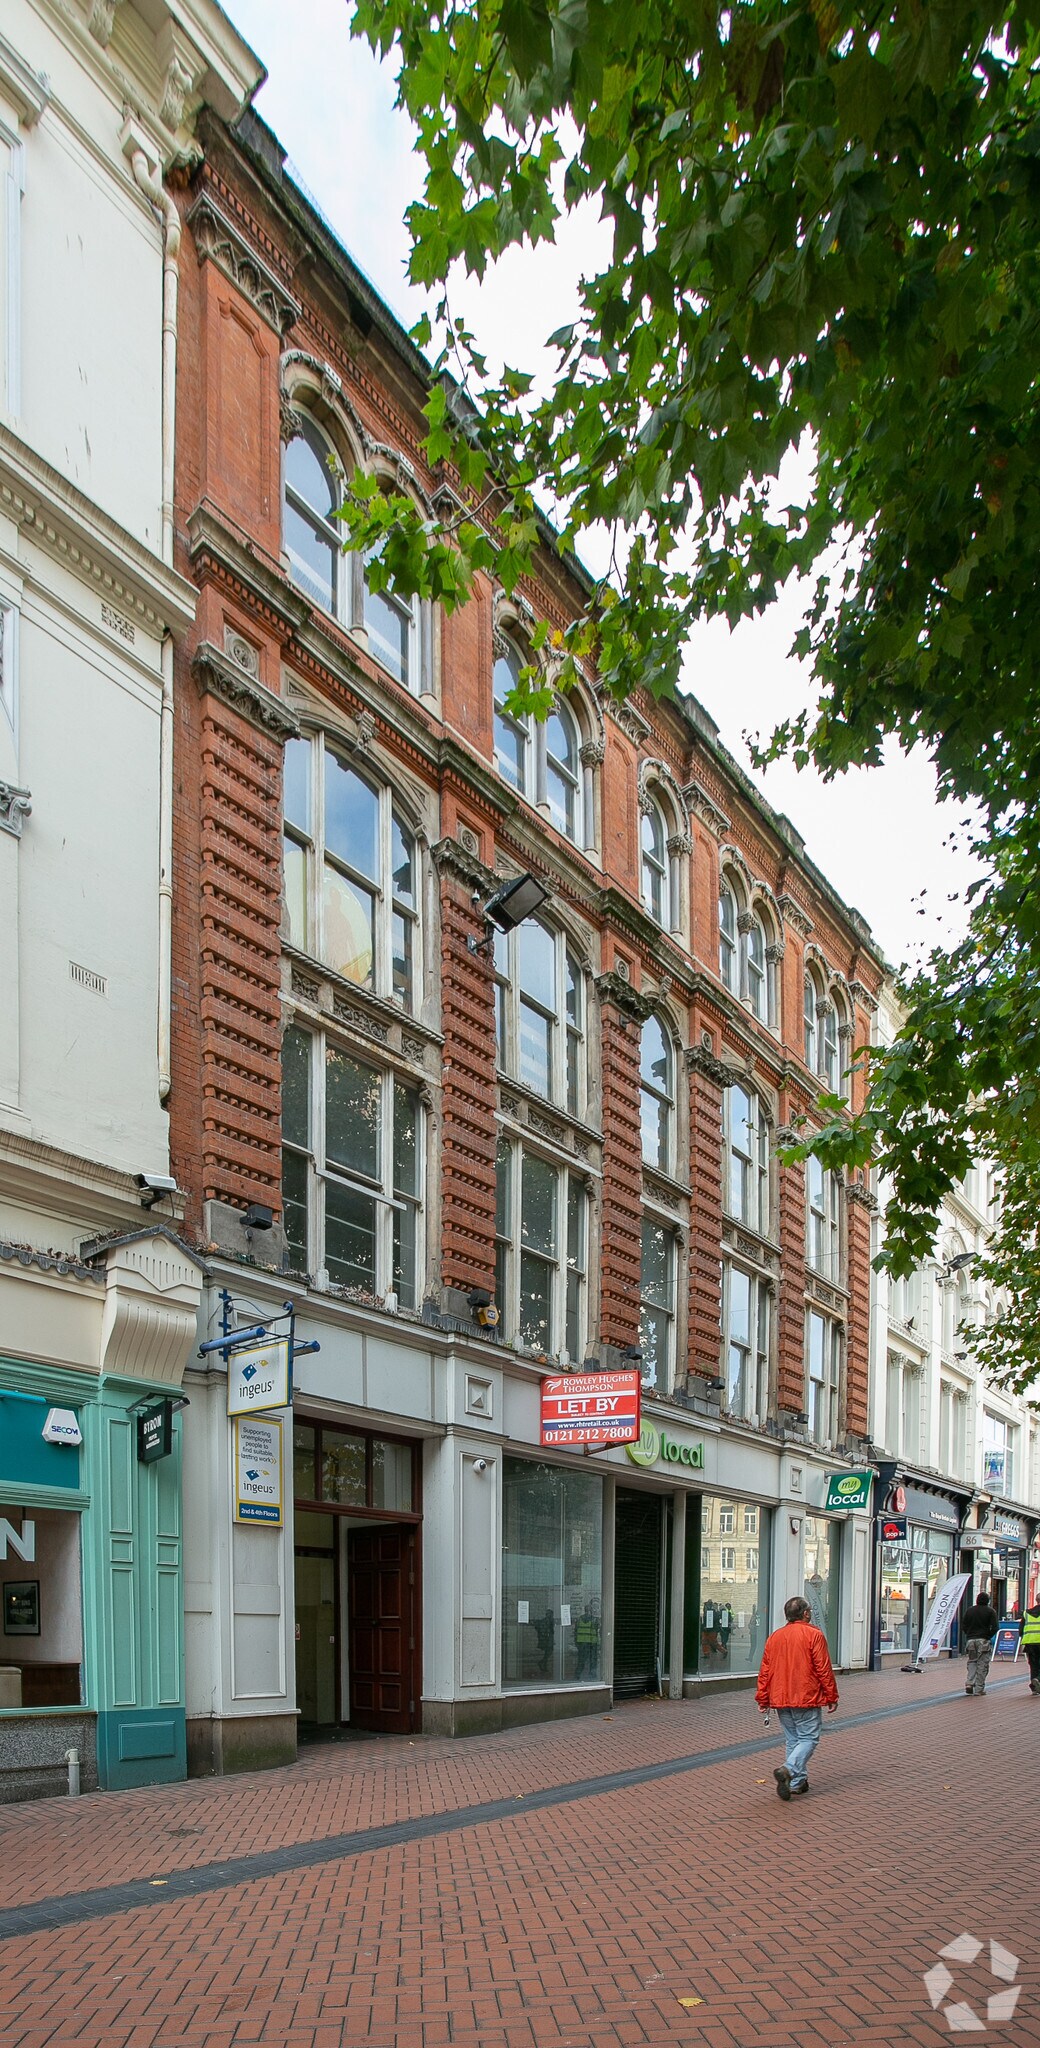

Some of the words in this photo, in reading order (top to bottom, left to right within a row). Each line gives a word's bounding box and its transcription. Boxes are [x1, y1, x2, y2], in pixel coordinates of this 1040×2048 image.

[563, 1377, 597, 1386] ROWLEY
[599, 1374, 634, 1383] HUGHES
[563, 1384, 614, 1393] THOMPSON
[557, 1399, 591, 1414] LET
[596, 1397, 619, 1411] BY
[143, 1414, 162, 1435] BYRON
[558, 1419, 620, 1428] www.rhtretail.co.uk
[51, 1425, 78, 1436] SECOM
[243, 1426, 271, 1438] Supporting
[545, 1430, 573, 1442] 0121
[577, 1429, 599, 1440] 212
[602, 1427, 632, 1439] 7800
[241, 1434, 272, 1443] unemployed
[661, 1432, 705, 1469] local
[241, 1453, 258, 1461] lasting
[841, 1480, 857, 1491] my
[828, 1491, 865, 1505] local
[965, 1535, 977, 1545] 86
[939, 1594, 950, 1608] ON
[935, 1608, 946, 1626] LIVE
